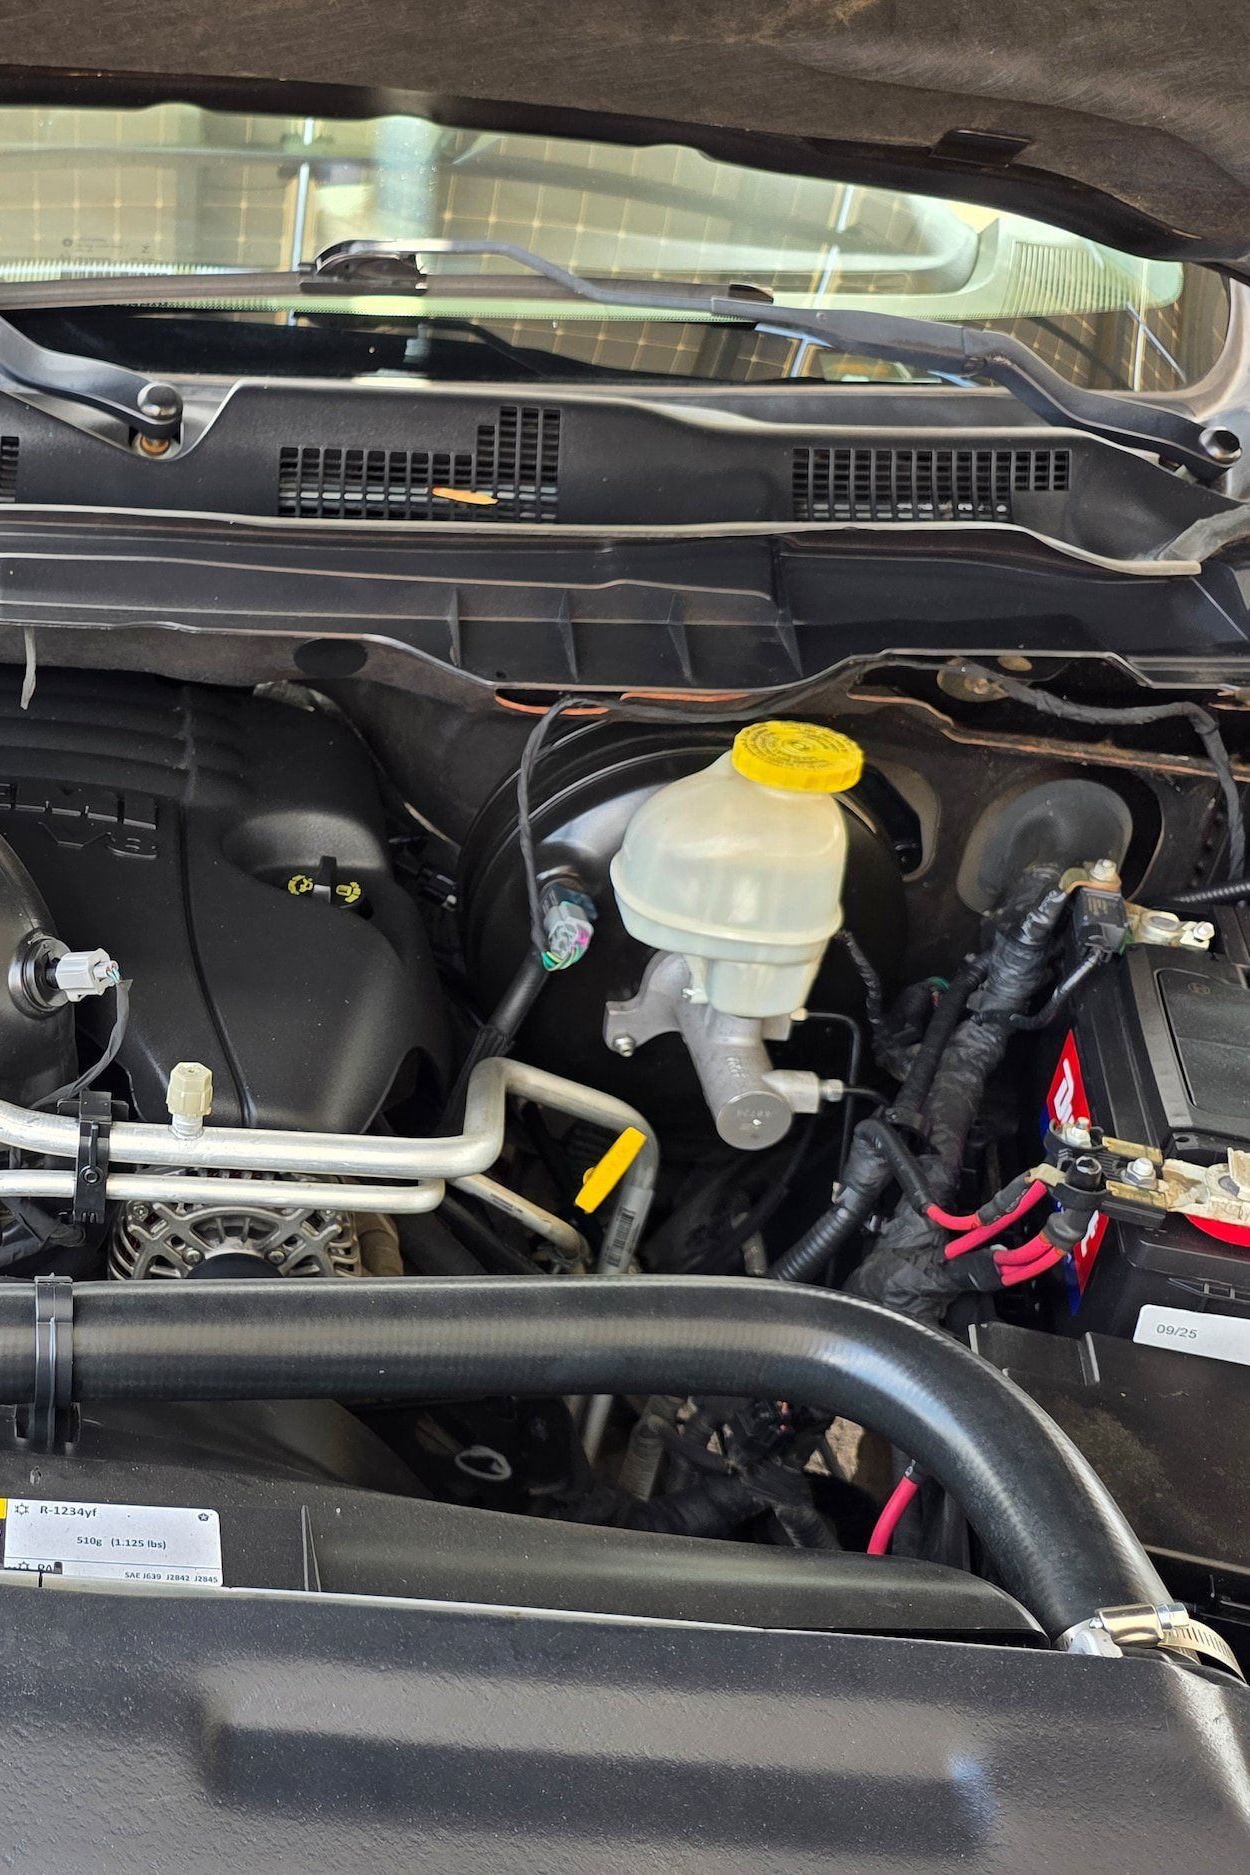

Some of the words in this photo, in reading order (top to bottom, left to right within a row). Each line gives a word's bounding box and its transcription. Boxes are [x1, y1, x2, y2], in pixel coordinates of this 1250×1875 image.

[1156, 1323, 1198, 1339] 09/25
[40, 1505, 98, 1519] R-1234yf
[76, 1536, 103, 1547] 510g
[111, 1537, 145, 1548] (1.125
[148, 1539, 167, 1550] lbs)
[125, 1571, 141, 1580] SAE
[143, 1572, 162, 1580] J639
[166, 1573, 190, 1582] J2842
[194, 1575, 219, 1583] J2845
